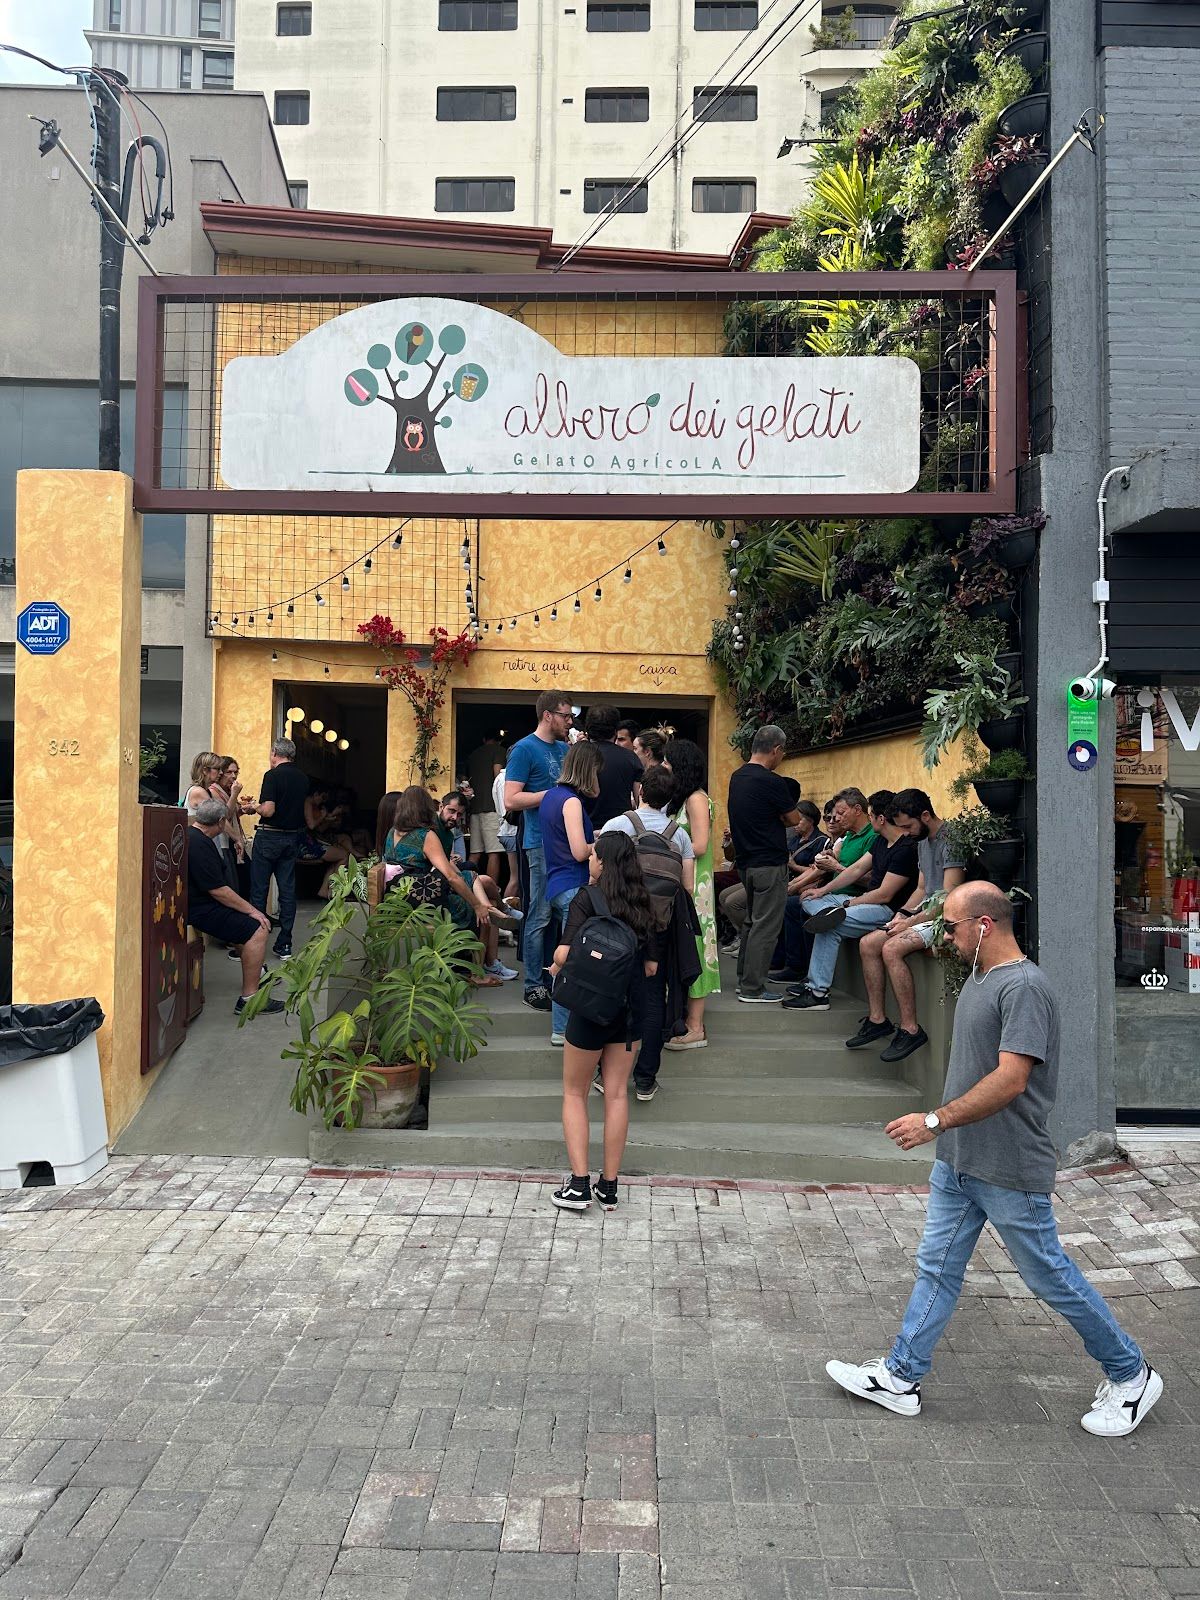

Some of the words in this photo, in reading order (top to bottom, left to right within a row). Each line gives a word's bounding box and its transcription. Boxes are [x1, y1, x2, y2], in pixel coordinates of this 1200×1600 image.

[504, 372, 651, 441] albero
[670, 381, 726, 440] dei
[735, 383, 861, 470] gelati
[29, 616, 59, 631] ADT
[502, 657, 537, 672] retire
[639, 663, 678, 676] caixa
[48, 740, 80, 756] 342
